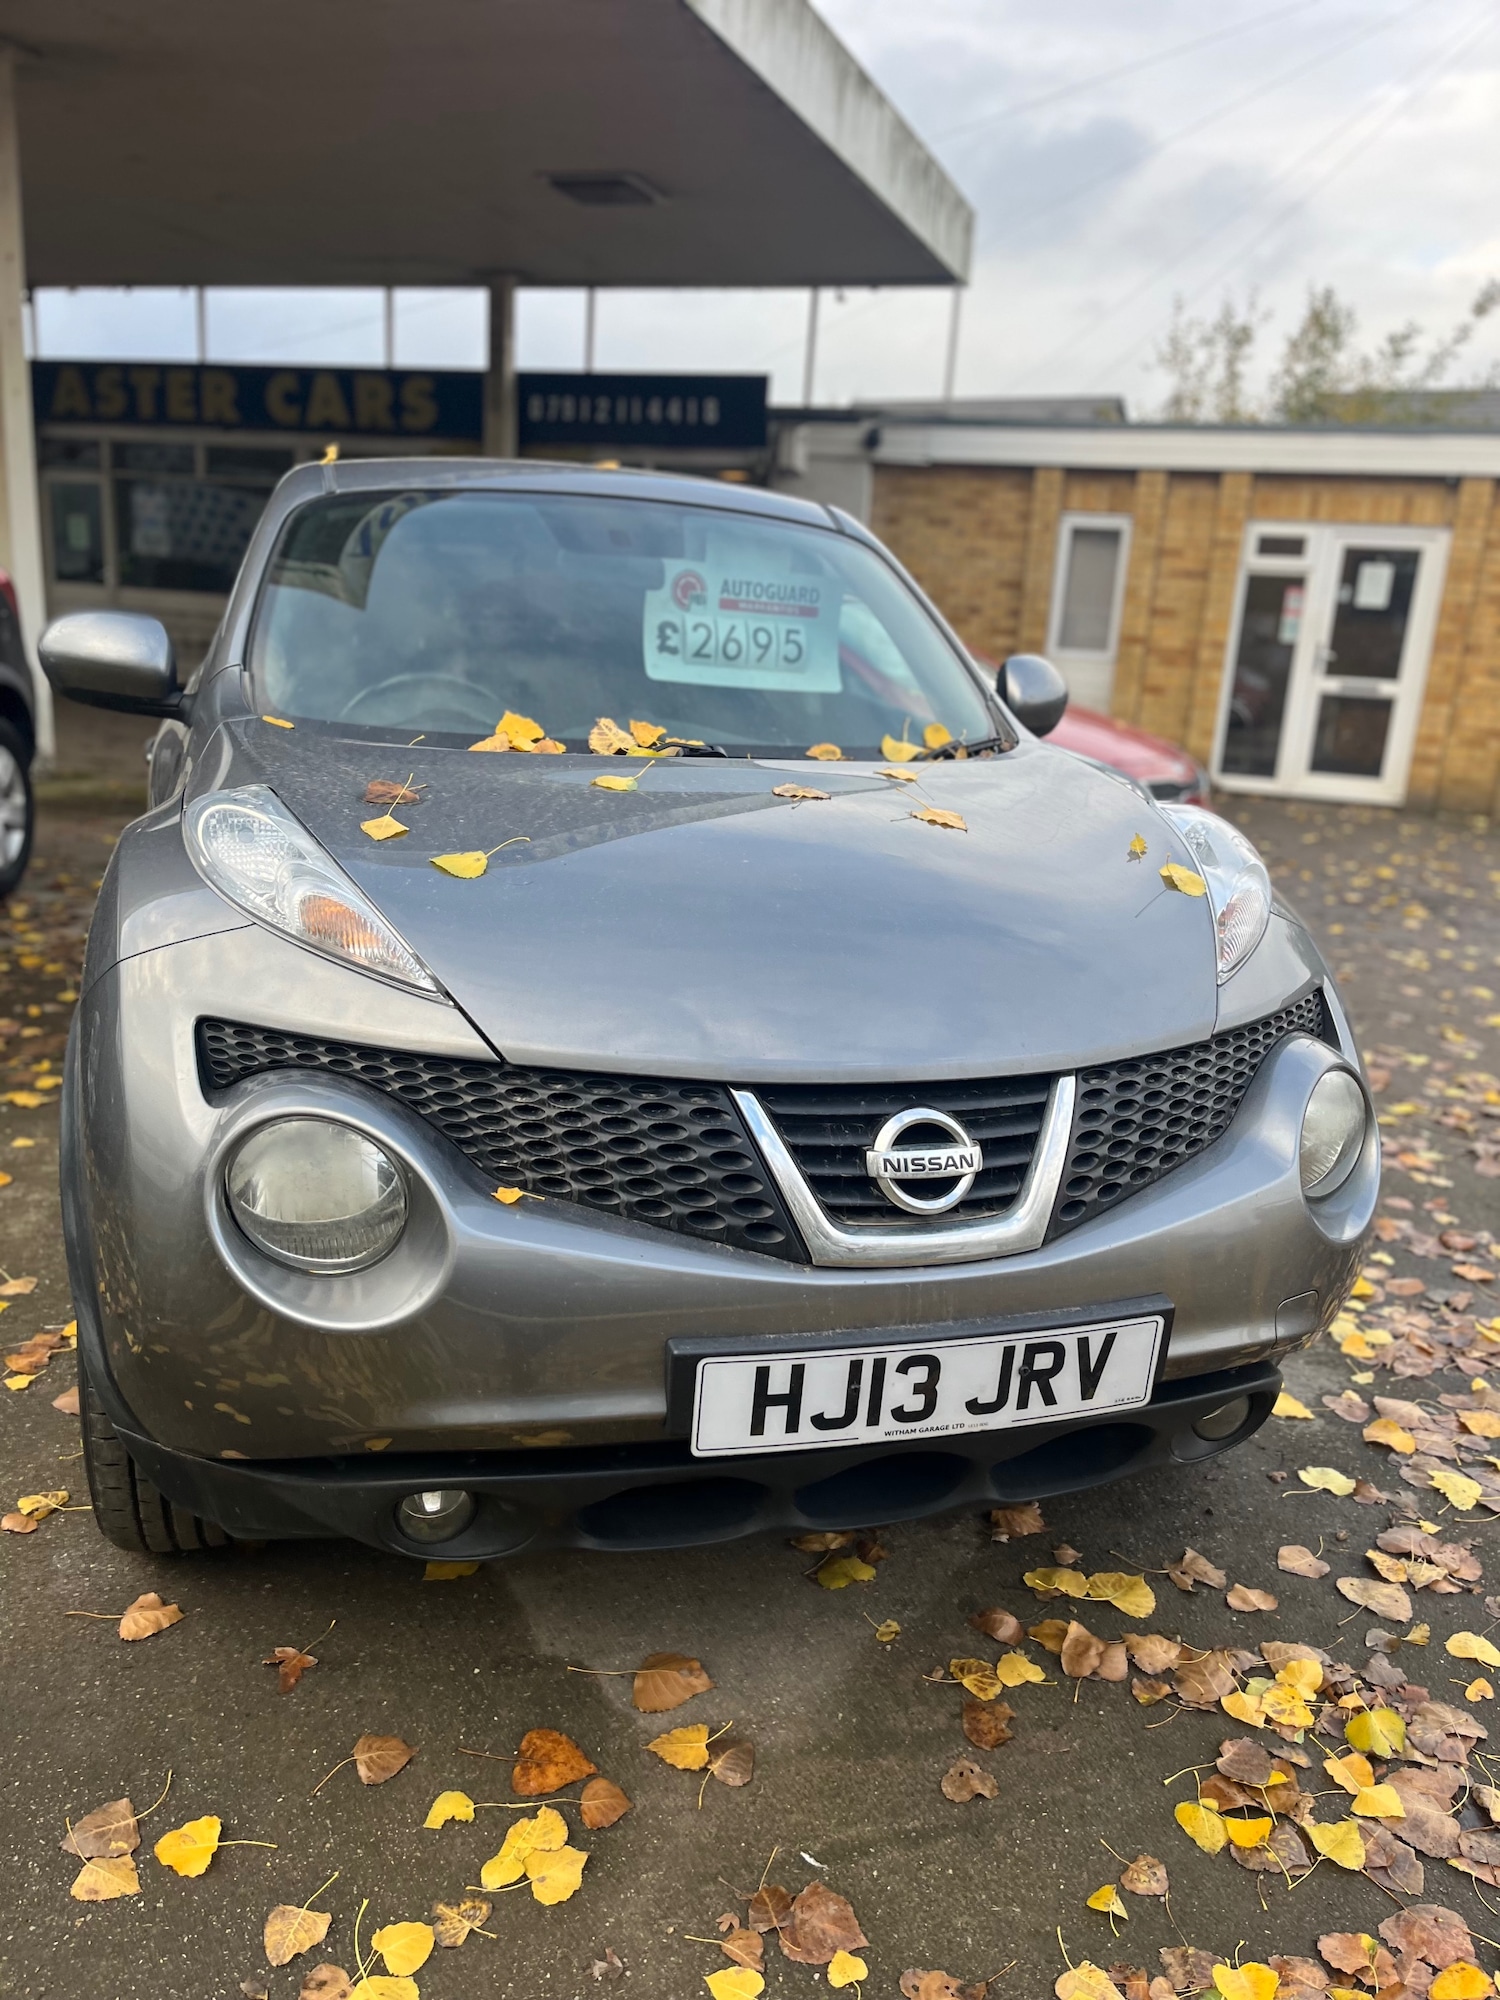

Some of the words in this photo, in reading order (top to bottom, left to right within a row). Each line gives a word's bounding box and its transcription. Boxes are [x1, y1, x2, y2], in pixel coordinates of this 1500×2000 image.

[50, 367, 240, 422] ASTER
[264, 372, 438, 430] CARS
[720, 578, 821, 604] AUTOGUARD
[656, 621, 803, 664] £2695
[883, 1153, 974, 1173] NISSAN
[750, 1354, 942, 1436] HJ13
[964, 1331, 1118, 1416] JRV
[884, 1428, 917, 1436] WITHAM
[918, 1424, 950, 1433] GARAGE
[951, 1422, 965, 1430] LTD
